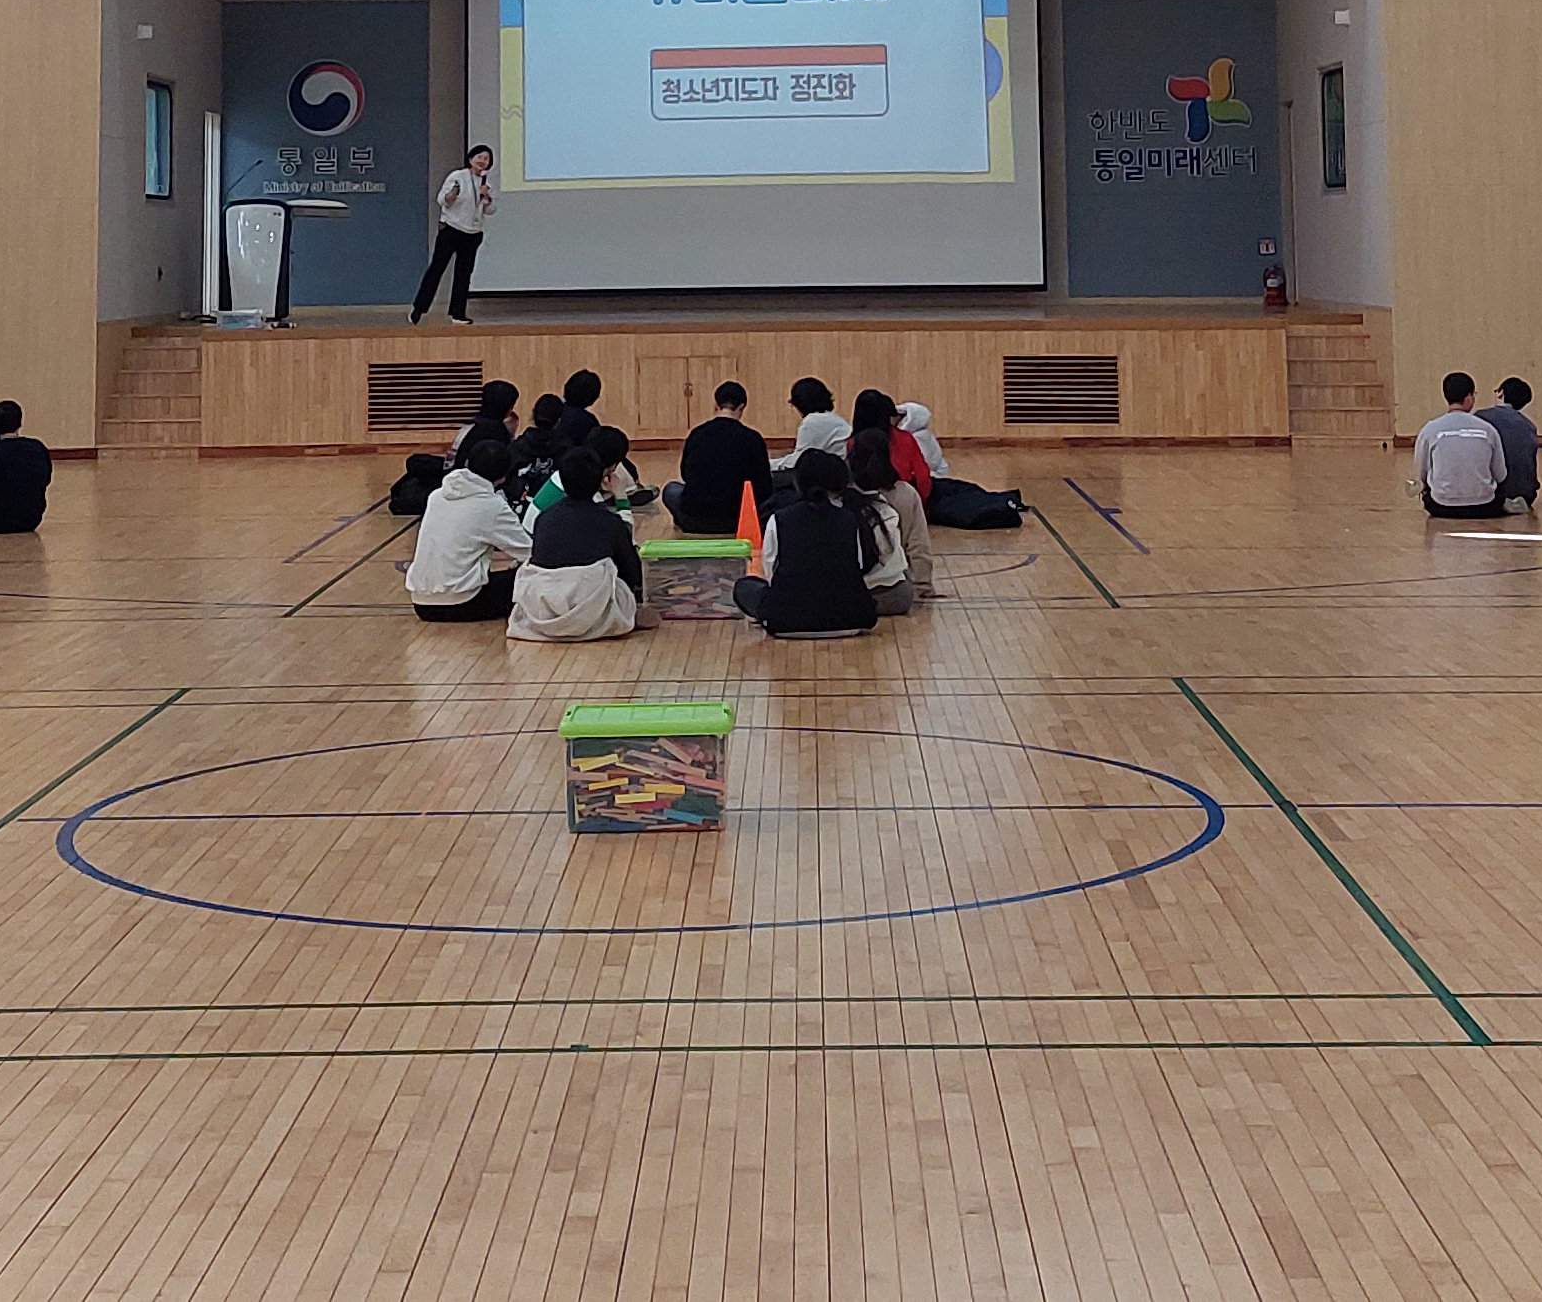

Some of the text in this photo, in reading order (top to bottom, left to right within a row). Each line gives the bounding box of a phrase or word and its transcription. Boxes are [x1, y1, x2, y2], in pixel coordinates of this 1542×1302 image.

[661, 72, 857, 105] 청소년지도자 정진화
[1087, 109, 1174, 142] 한반도
[277, 146, 375, 176] 통일부
[1089, 145, 1258, 183] 통일미래센터
[262, 180, 309, 196] Ministry
[310, 180, 324, 193] of
